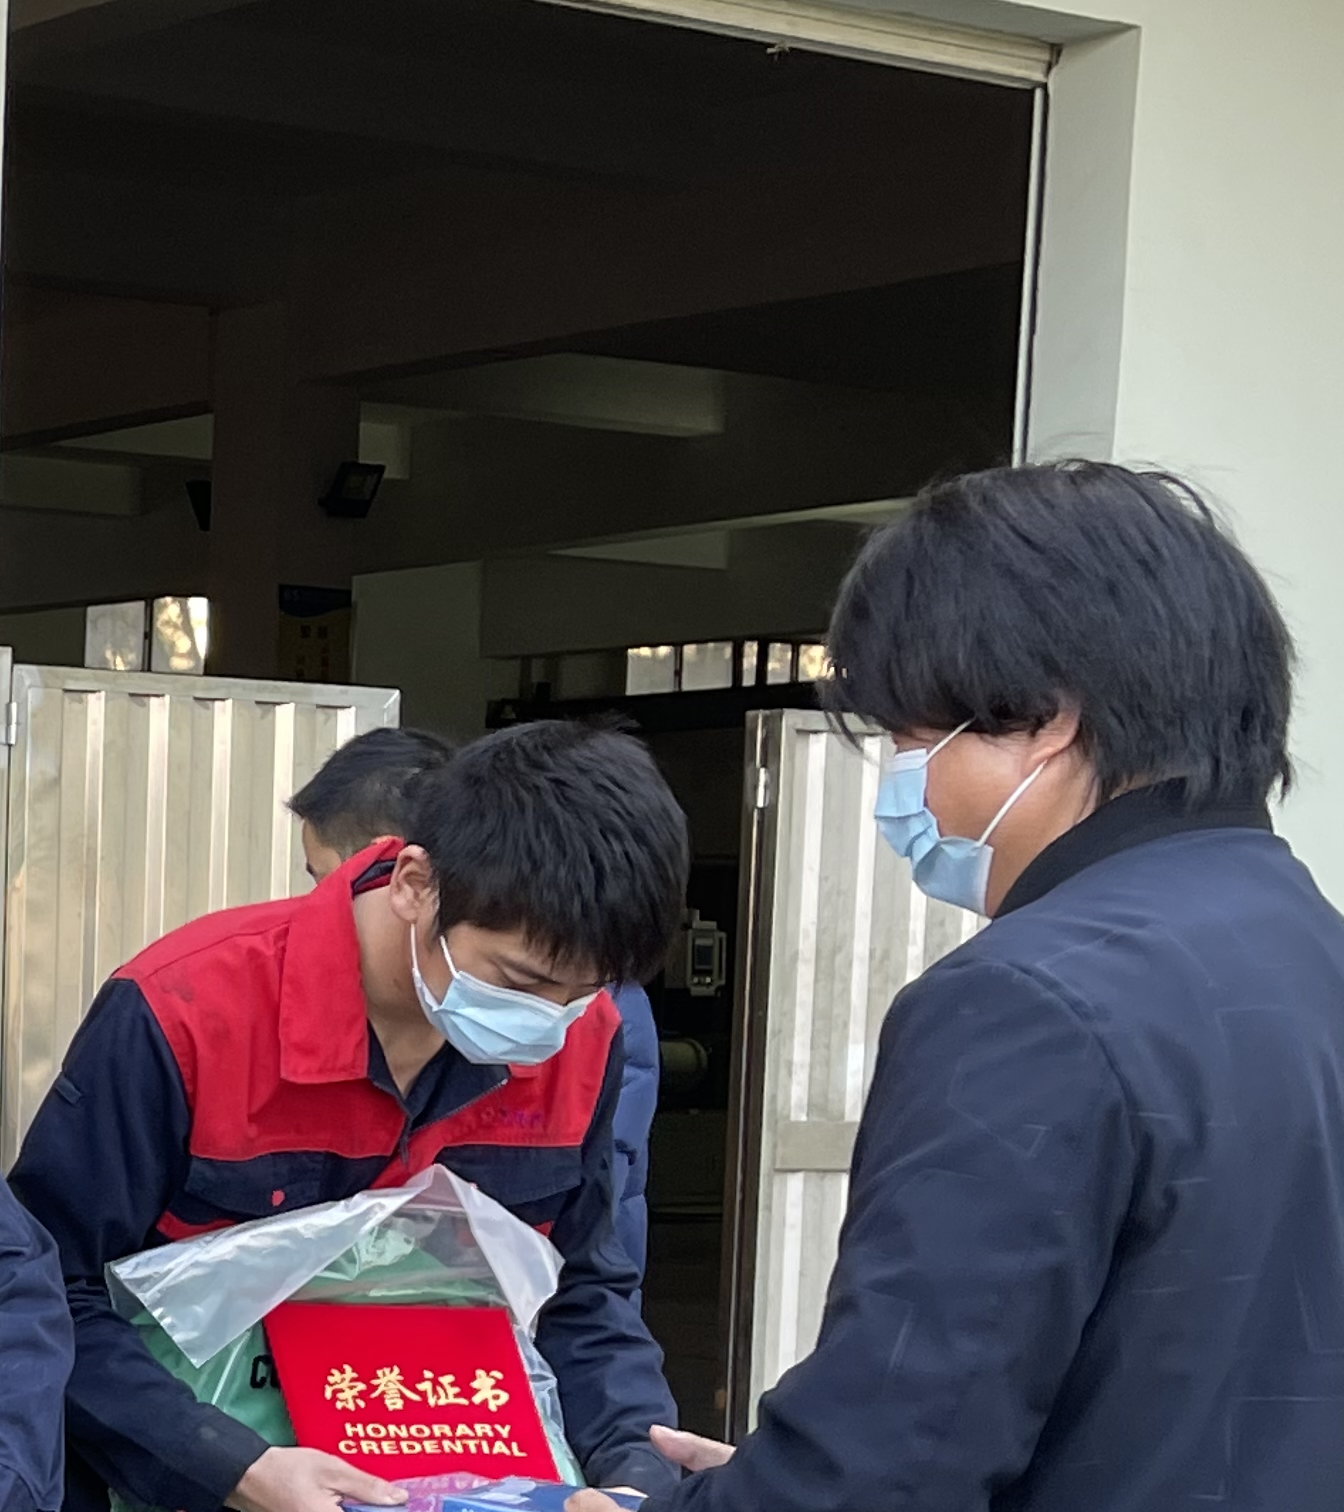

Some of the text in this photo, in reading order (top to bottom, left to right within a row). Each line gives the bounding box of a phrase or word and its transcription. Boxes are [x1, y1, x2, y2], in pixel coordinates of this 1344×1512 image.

[324, 1364, 510, 1412] 荣誉证书
[345, 1422, 511, 1438] HONORARY
[338, 1439, 527, 1457] CREDENTIAL
